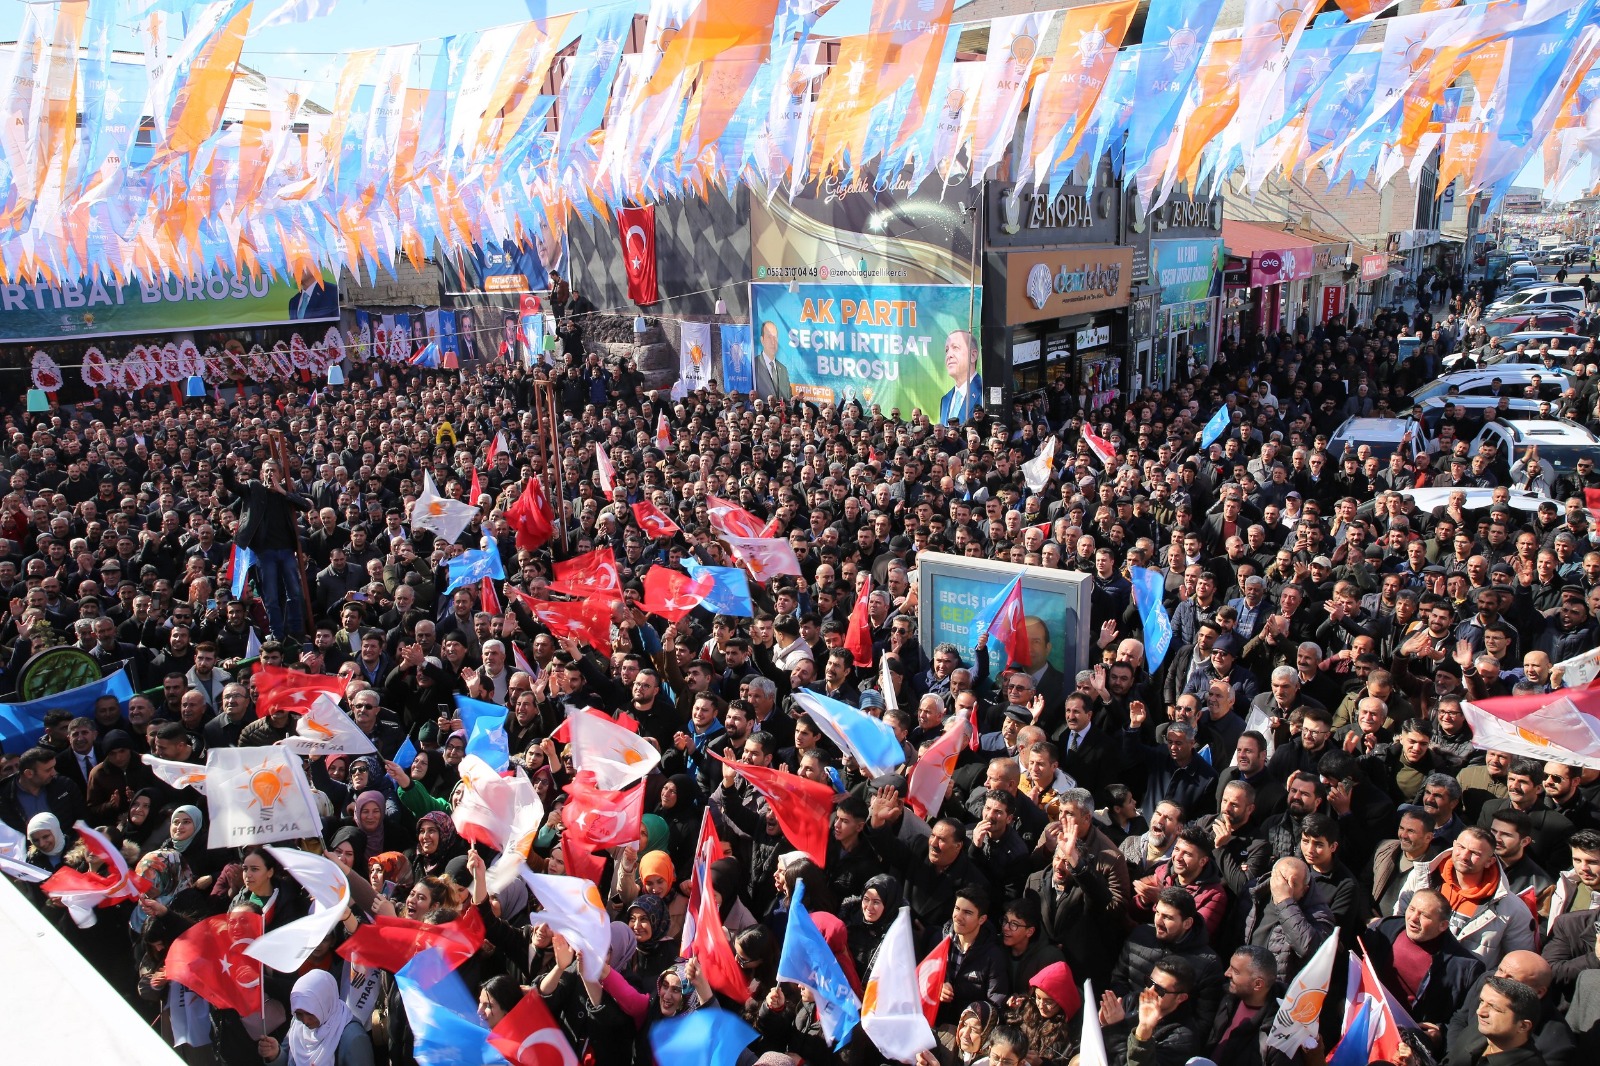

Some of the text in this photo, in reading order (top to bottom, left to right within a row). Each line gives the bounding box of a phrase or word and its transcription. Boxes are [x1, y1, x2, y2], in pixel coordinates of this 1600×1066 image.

[1060, 73, 1076, 84] AK
[1029, 193, 1094, 229] ZENOBIA
[1172, 200, 1210, 228] ZENOBIA
[797, 267, 807, 277] 04
[808, 267, 818, 277] 49
[1261, 258, 1280, 268] eve
[0, 279, 125, 311] RTİBAT
[800, 297, 917, 328] AK PARTİ
[788, 328, 932, 357] SEÇİM İRTİBAT
[940, 590, 979, 609] ERCİŞ
[940, 622, 970, 635] BELED
